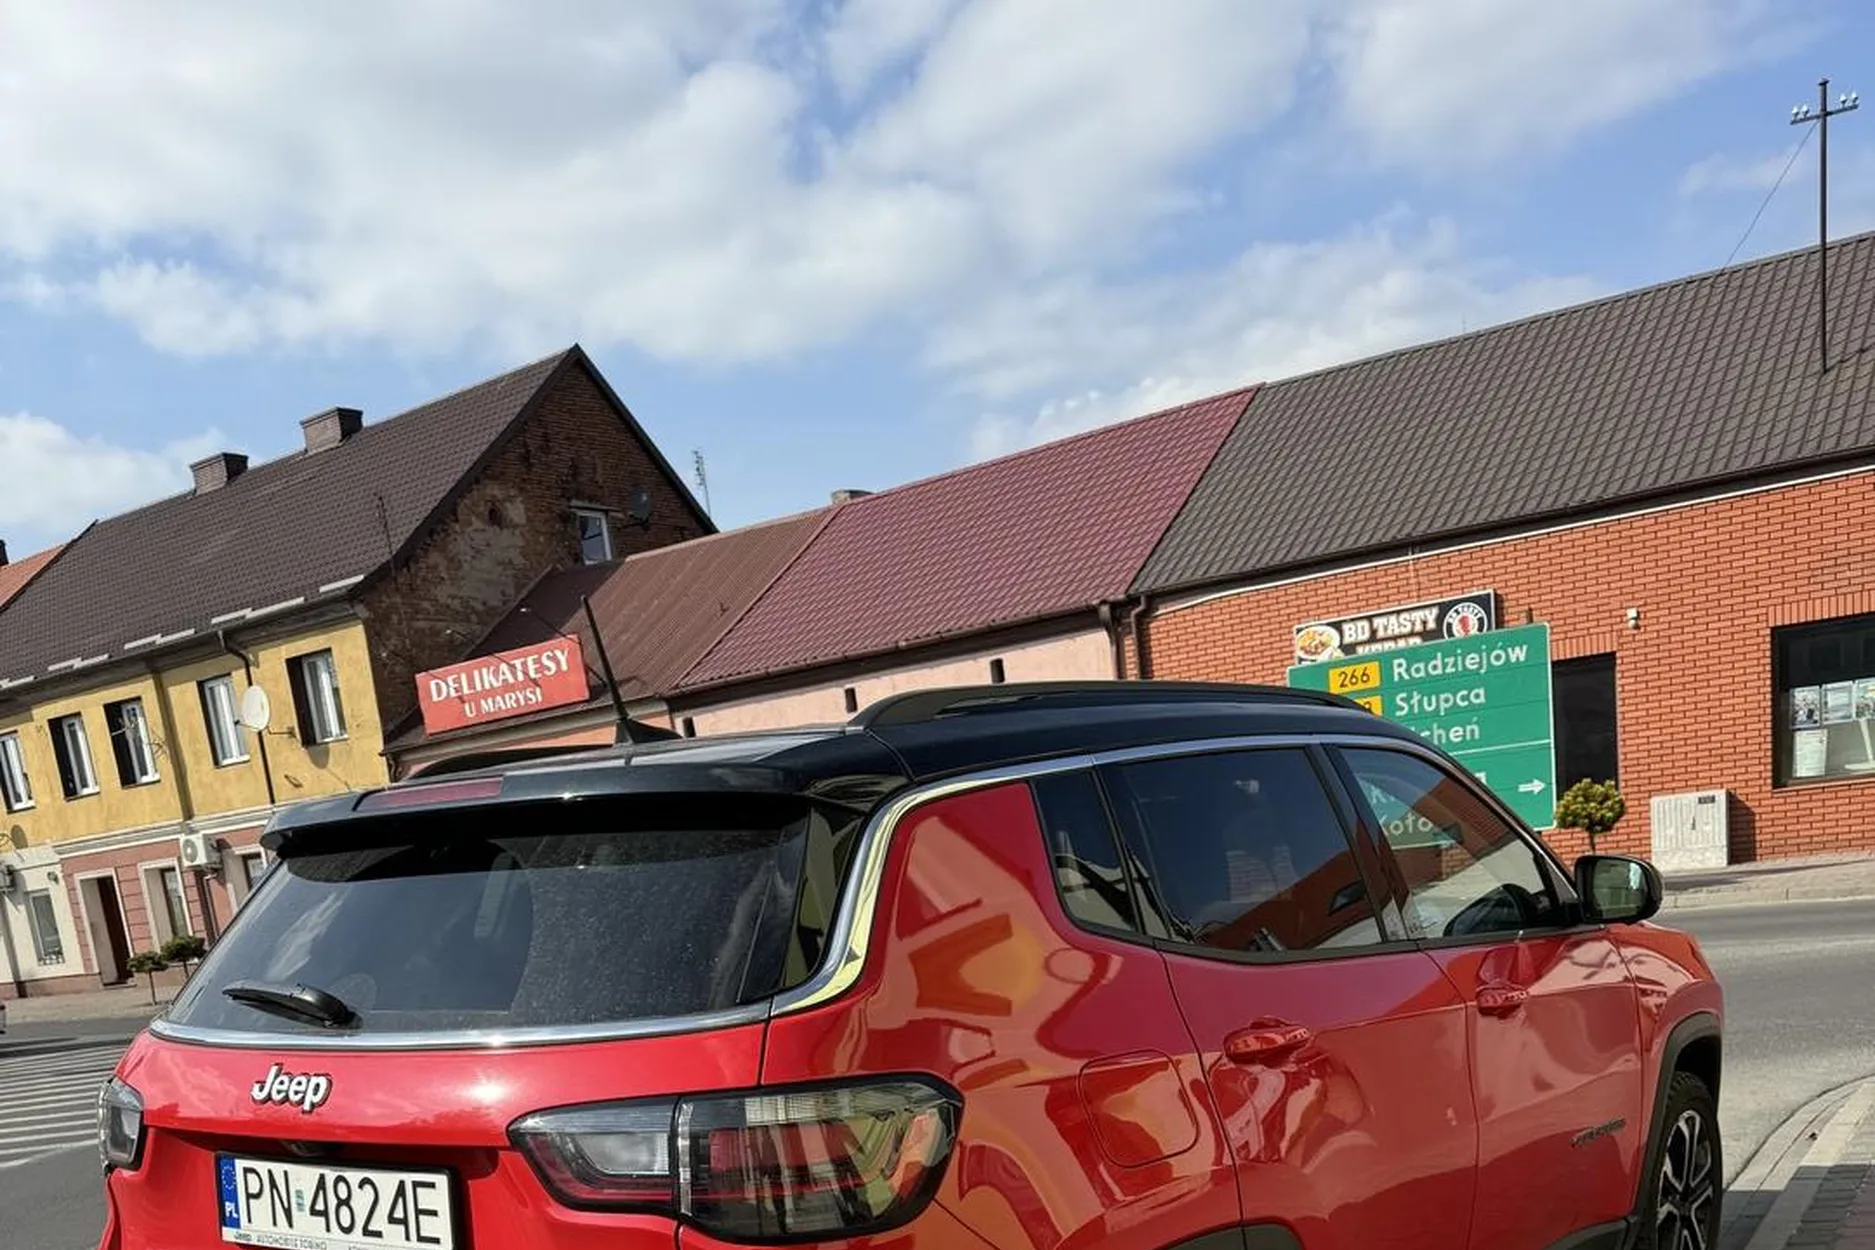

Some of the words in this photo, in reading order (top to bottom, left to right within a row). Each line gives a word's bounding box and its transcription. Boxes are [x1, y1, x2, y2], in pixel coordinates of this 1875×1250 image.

[1342, 619, 1371, 645] BD
[1372, 606, 1439, 639] TASTY
[429, 648, 570, 702] DELIKATESY
[1338, 667, 1371, 688] 266
[1392, 643, 1528, 682] Radziejów
[464, 702, 476, 718] U
[481, 687, 542, 715] MARYSI
[1395, 686, 1486, 717] Słupca
[251, 1063, 332, 1113] Jeep
[225, 1201, 238, 1218] PL
[242, 1167, 293, 1229] PN
[309, 1173, 441, 1245] 4824E
